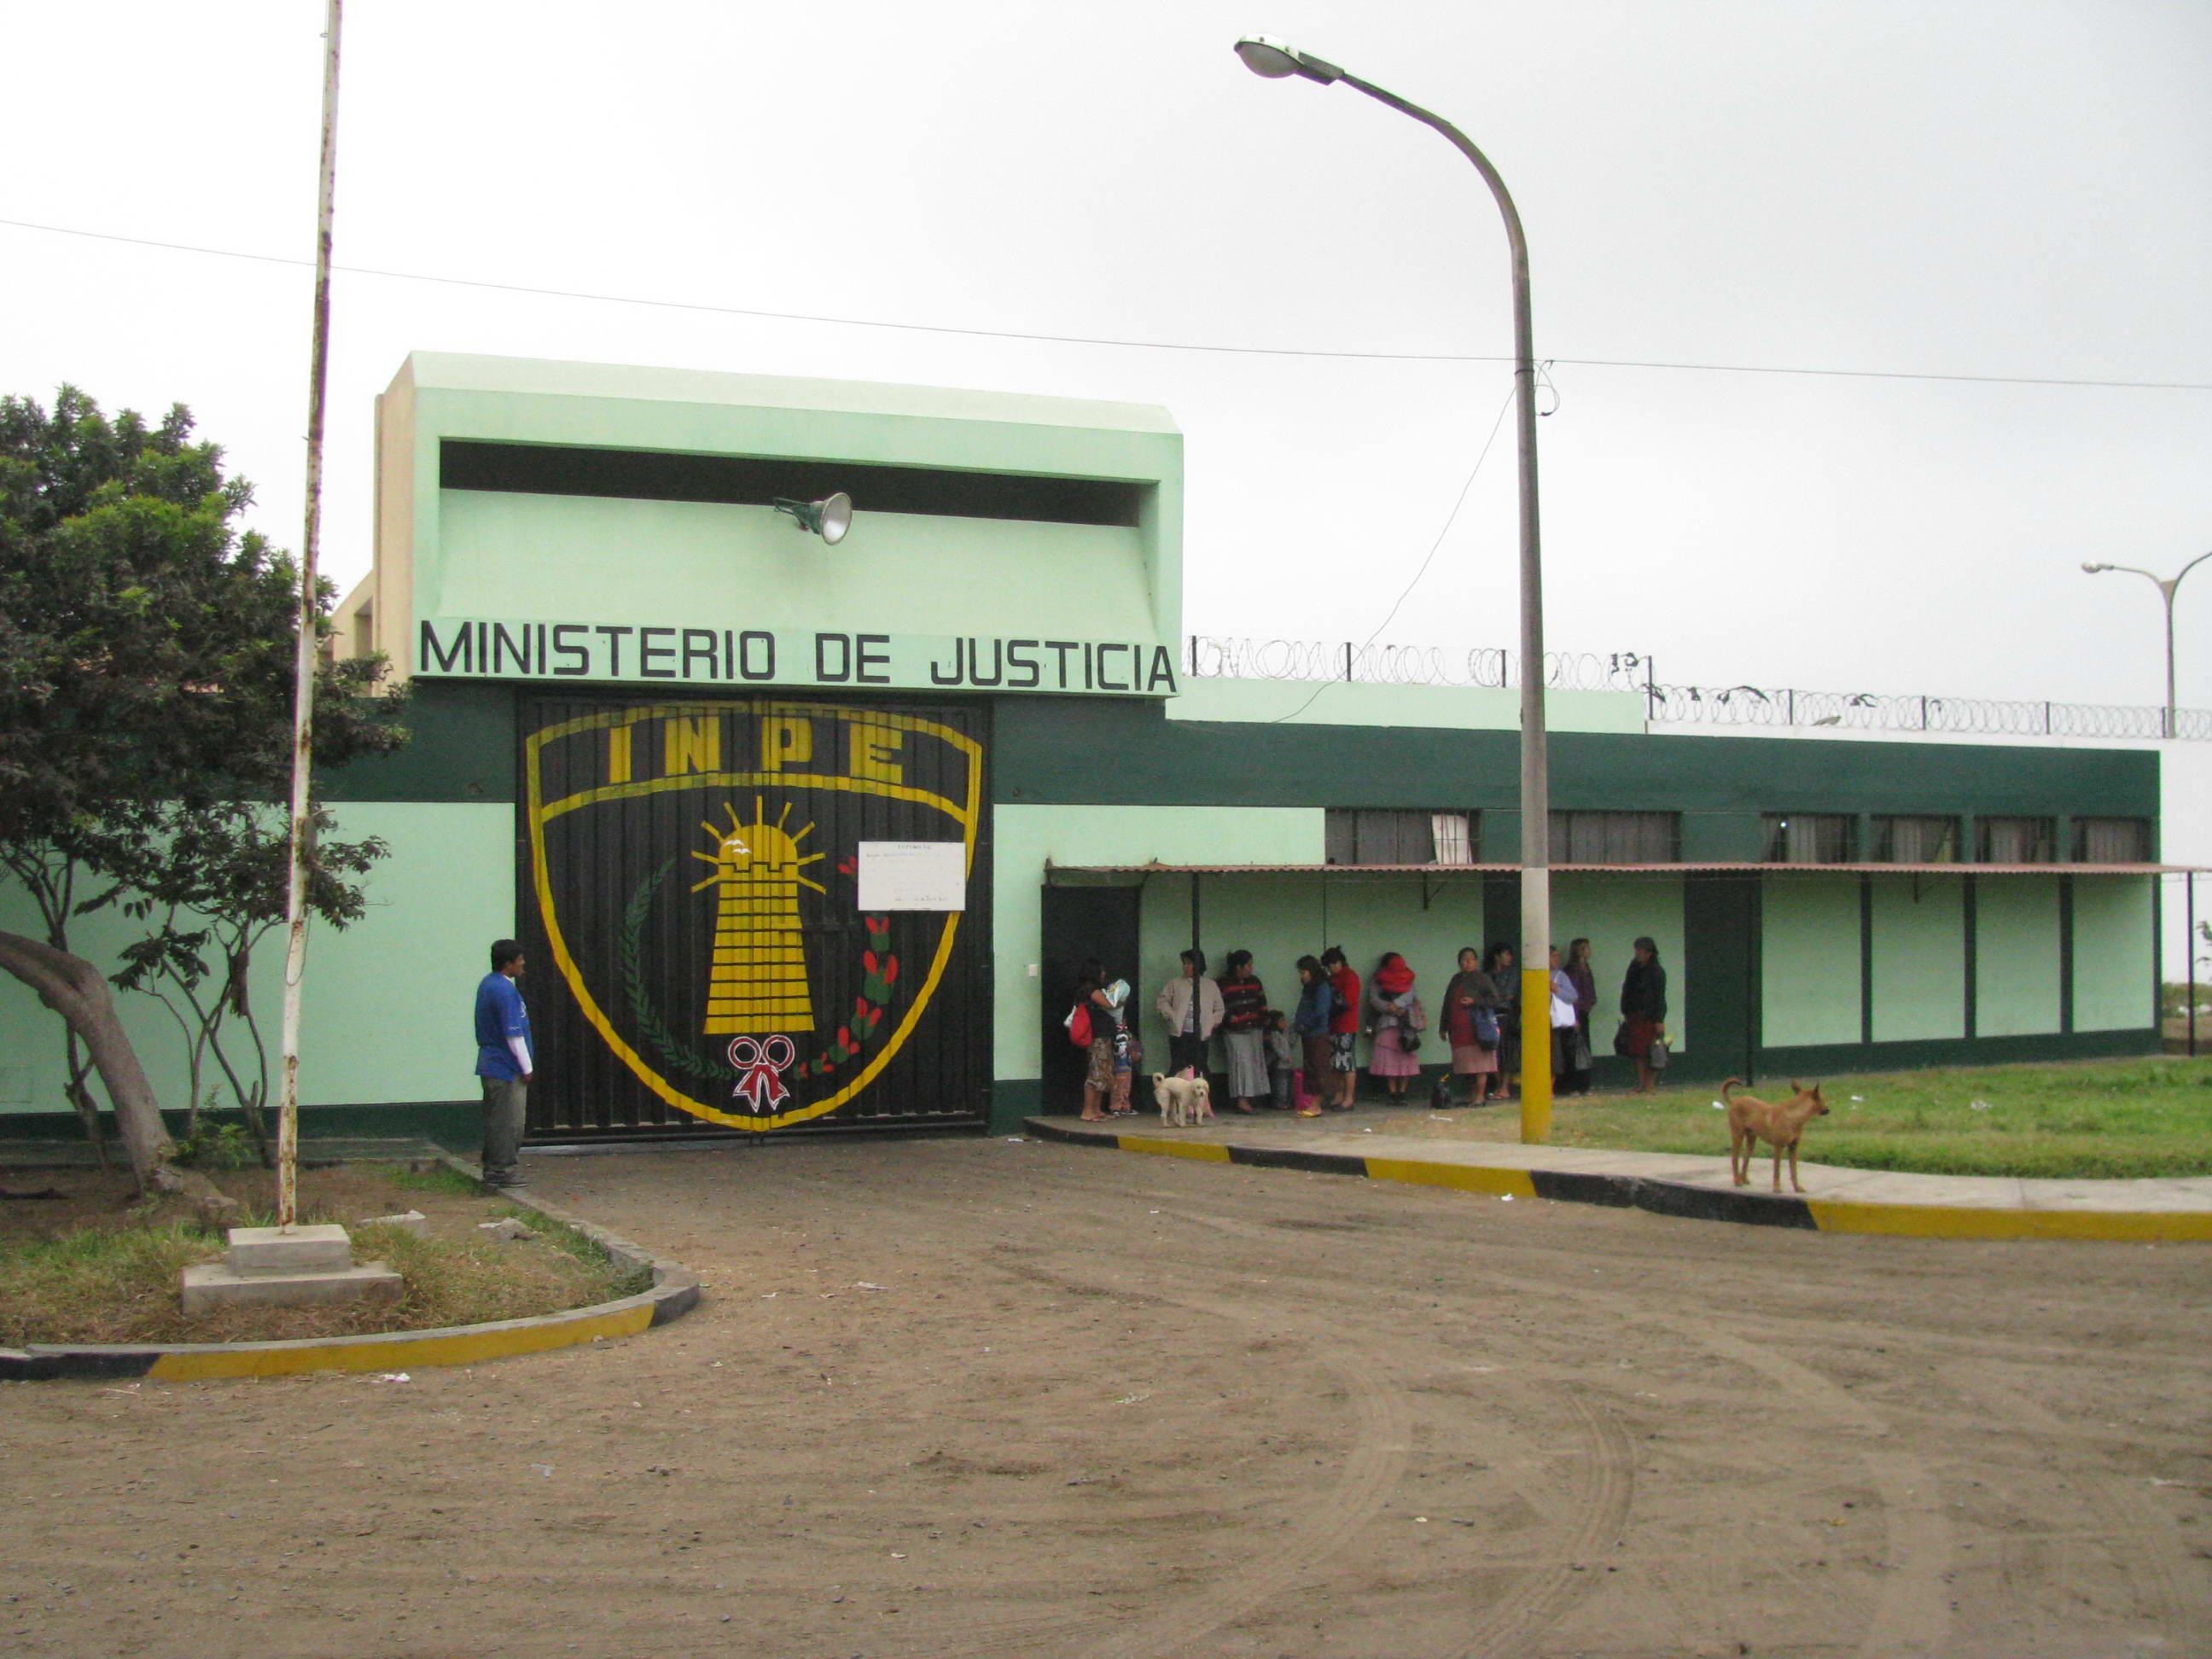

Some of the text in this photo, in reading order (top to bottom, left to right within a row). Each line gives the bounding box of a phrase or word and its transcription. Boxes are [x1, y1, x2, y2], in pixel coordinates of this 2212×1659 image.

[421, 620, 1177, 692] MINISTERIO DE JUSTICIA
[609, 716, 902, 785] INPE
